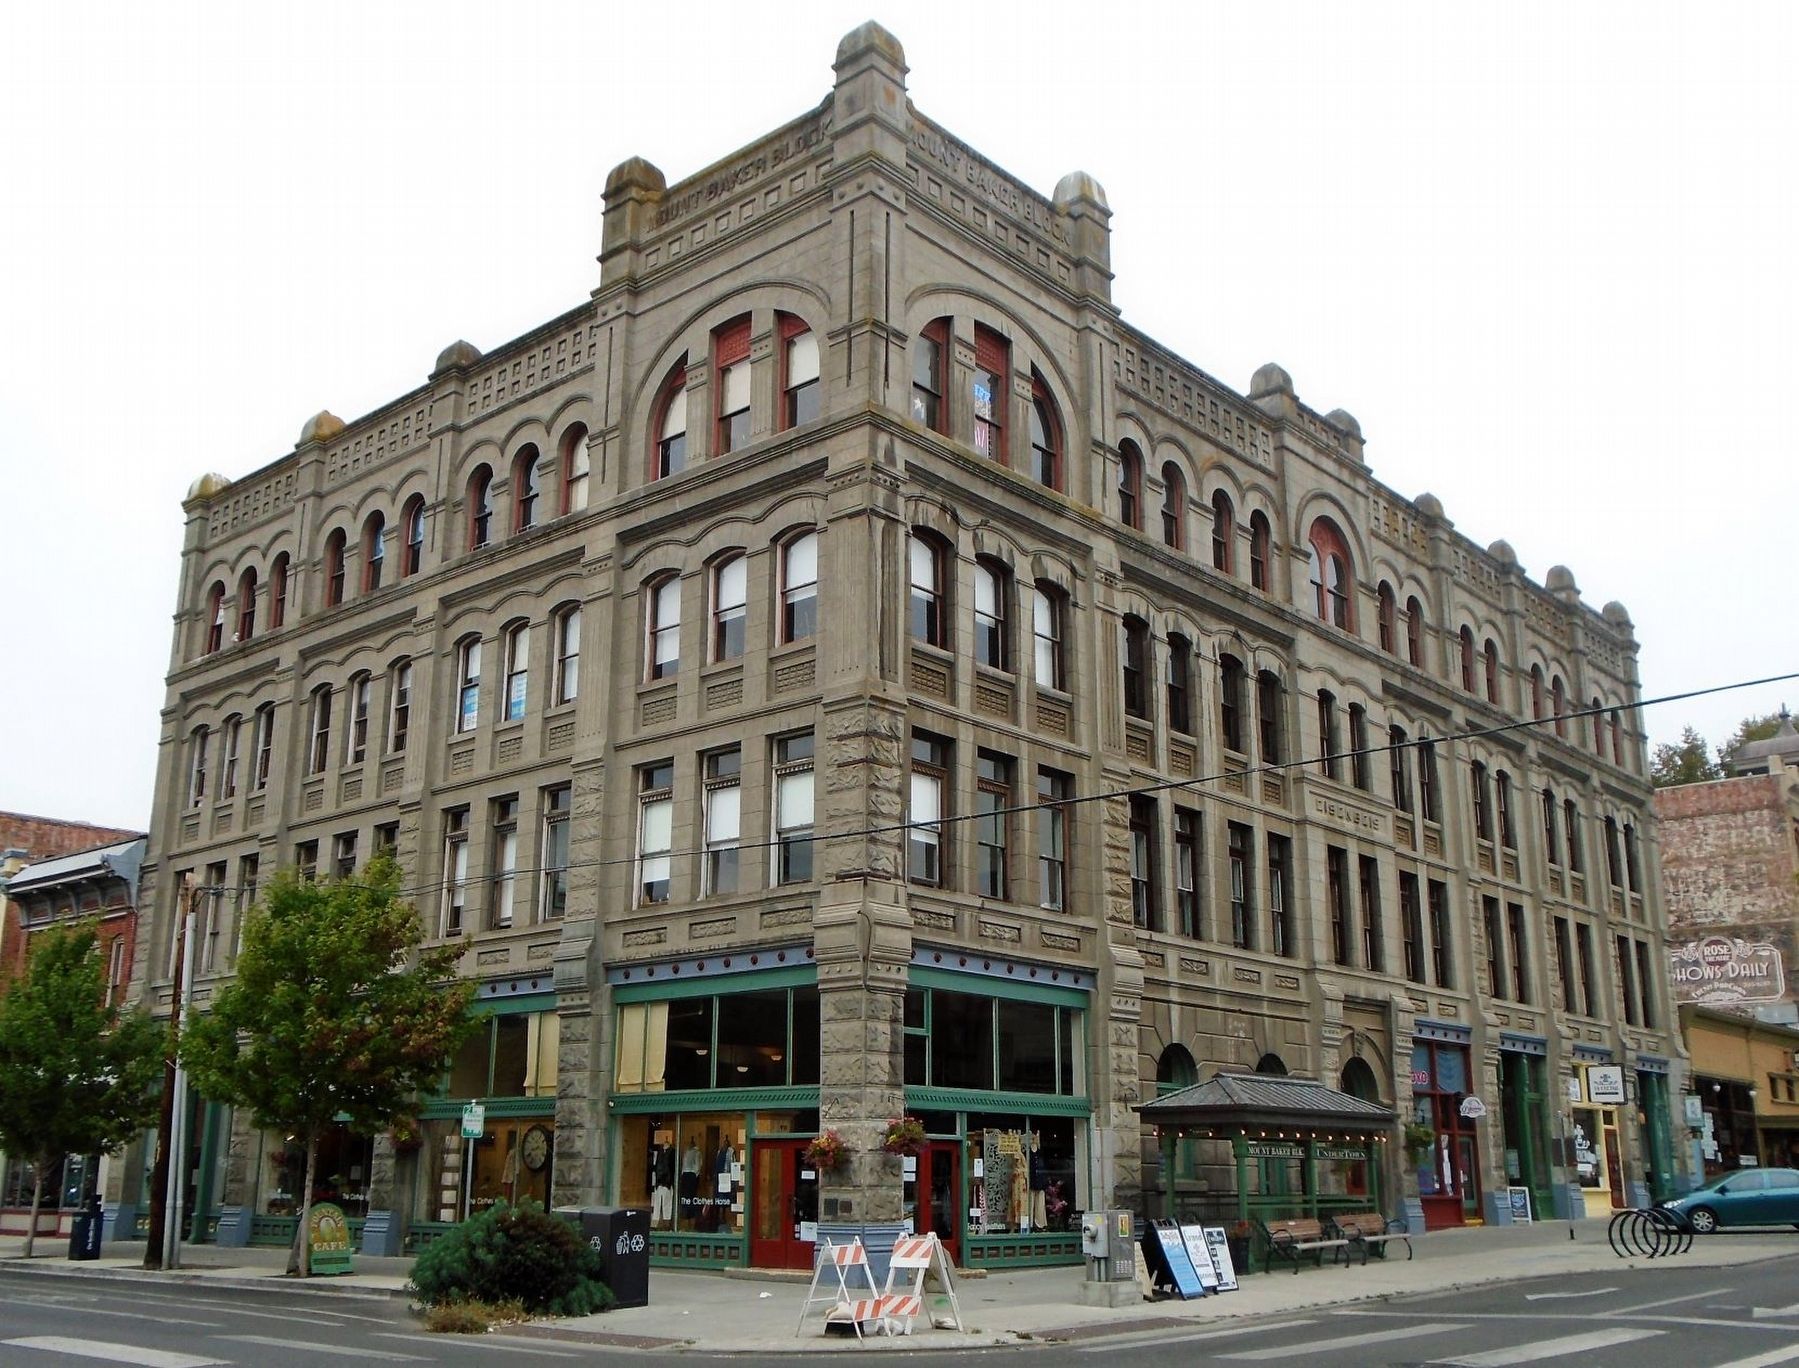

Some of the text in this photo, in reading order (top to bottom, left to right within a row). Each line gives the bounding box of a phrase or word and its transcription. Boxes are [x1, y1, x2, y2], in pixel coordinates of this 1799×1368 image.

[705, 156, 768, 201] BAKER
[771, 118, 833, 169] BLOCK
[966, 161, 1019, 211] BAKER
[1024, 199, 1072, 247] BLOCK
[1703, 944, 1731, 956] ROSE
[1672, 962, 1770, 981] HOWS DAILY
[681, 1196, 731, 1206] The Clothes Horse
[313, 1241, 347, 1251] CAFE
